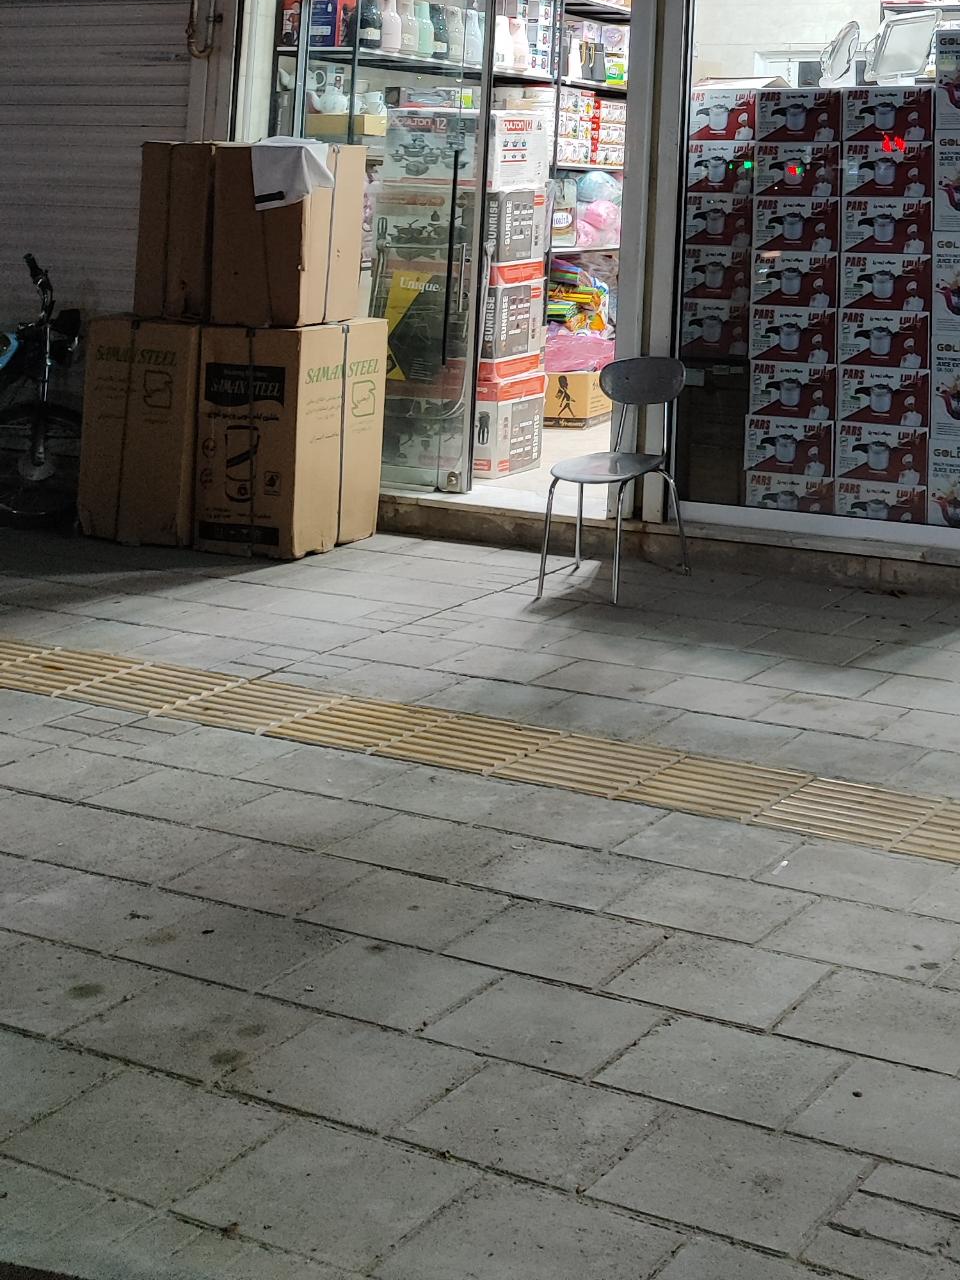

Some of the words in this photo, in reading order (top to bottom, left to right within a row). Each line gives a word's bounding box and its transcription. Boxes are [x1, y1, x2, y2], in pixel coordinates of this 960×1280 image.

[691, 92, 704, 101] ARS
[760, 92, 781, 101] PARS
[848, 90, 868, 100] PARS
[435, 118, 446, 129] 12
[688, 144, 702, 153] ARS
[758, 146, 779, 155] PARS
[847, 145, 868, 154] PARS
[687, 196, 702, 205] ARS
[757, 200, 778, 210] PARS
[846, 201, 867, 210] PARS
[504, 201, 512, 245] SUNRISE
[686, 249, 701, 258] ARS
[845, 257, 866, 267] PARS
[400, 277, 440, 293] Unique
[683, 302, 698, 312] ARS
[484, 296, 494, 342] SUNRISE
[500, 295, 509, 341] SUNRISE
[753, 309, 774, 319] PARS
[842, 312, 864, 322] PARS
[138, 349, 177, 366] STEEL
[348, 358, 379, 378] STEEL
[754, 365, 774, 374] PARS
[842, 370, 864, 380] PARS
[750, 420, 770, 430] PARS
[840, 426, 862, 436] PARS
[750, 475, 771, 486] PARS
[838, 484, 860, 494] PARS
